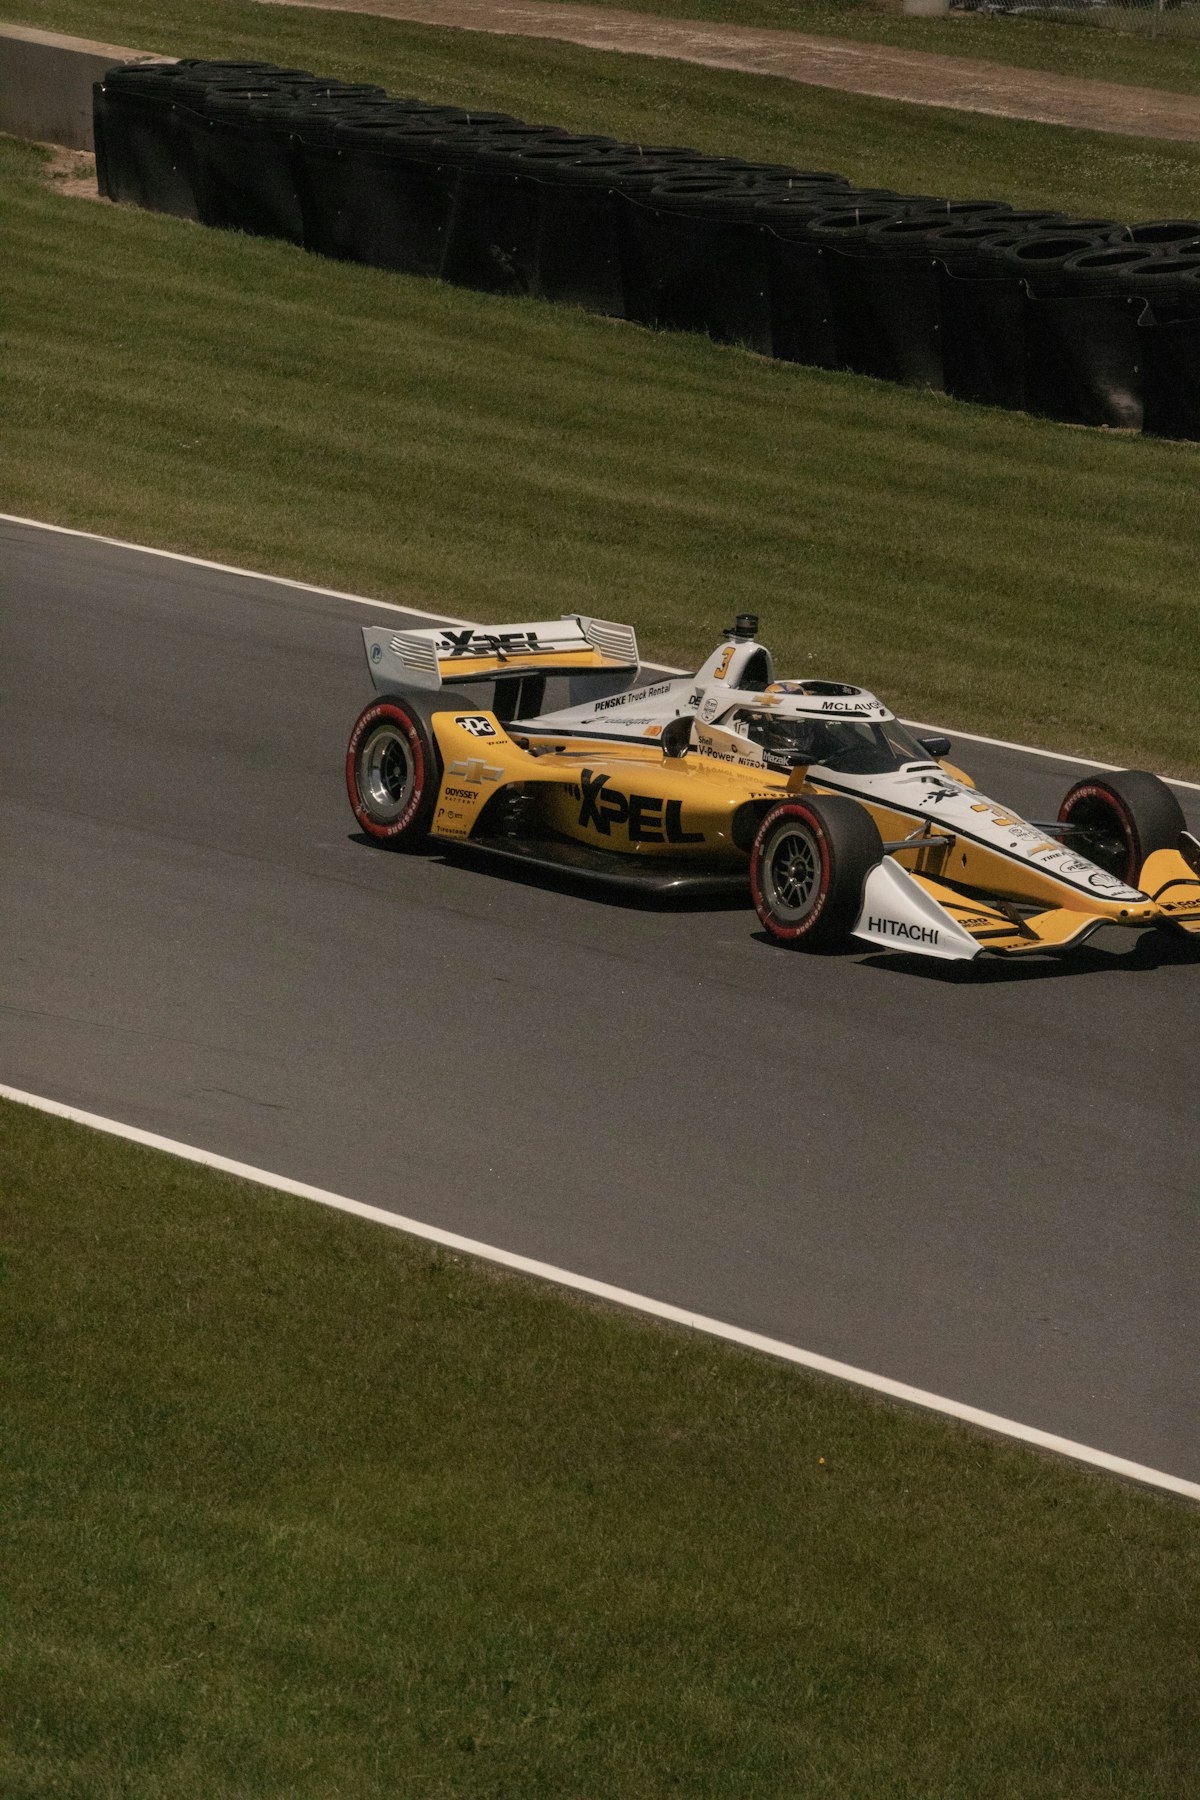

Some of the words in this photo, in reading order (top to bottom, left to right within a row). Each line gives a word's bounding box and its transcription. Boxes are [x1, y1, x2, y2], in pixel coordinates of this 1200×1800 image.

[714, 647, 736, 679] 3
[594, 695, 626, 712] PENSKE
[628, 692, 646, 703] Truck
[648, 683, 671, 697] Rental
[457, 718, 494, 735] PPG
[698, 735, 712, 746] Shell
[699, 744, 735, 762] V-Power
[763, 751, 789, 766] Mazak
[445, 787, 479, 800] ODYSSEY
[1064, 786, 1097, 811] Firestone
[578, 768, 705, 843] XPEL
[868, 916, 940, 944] HITACHI
